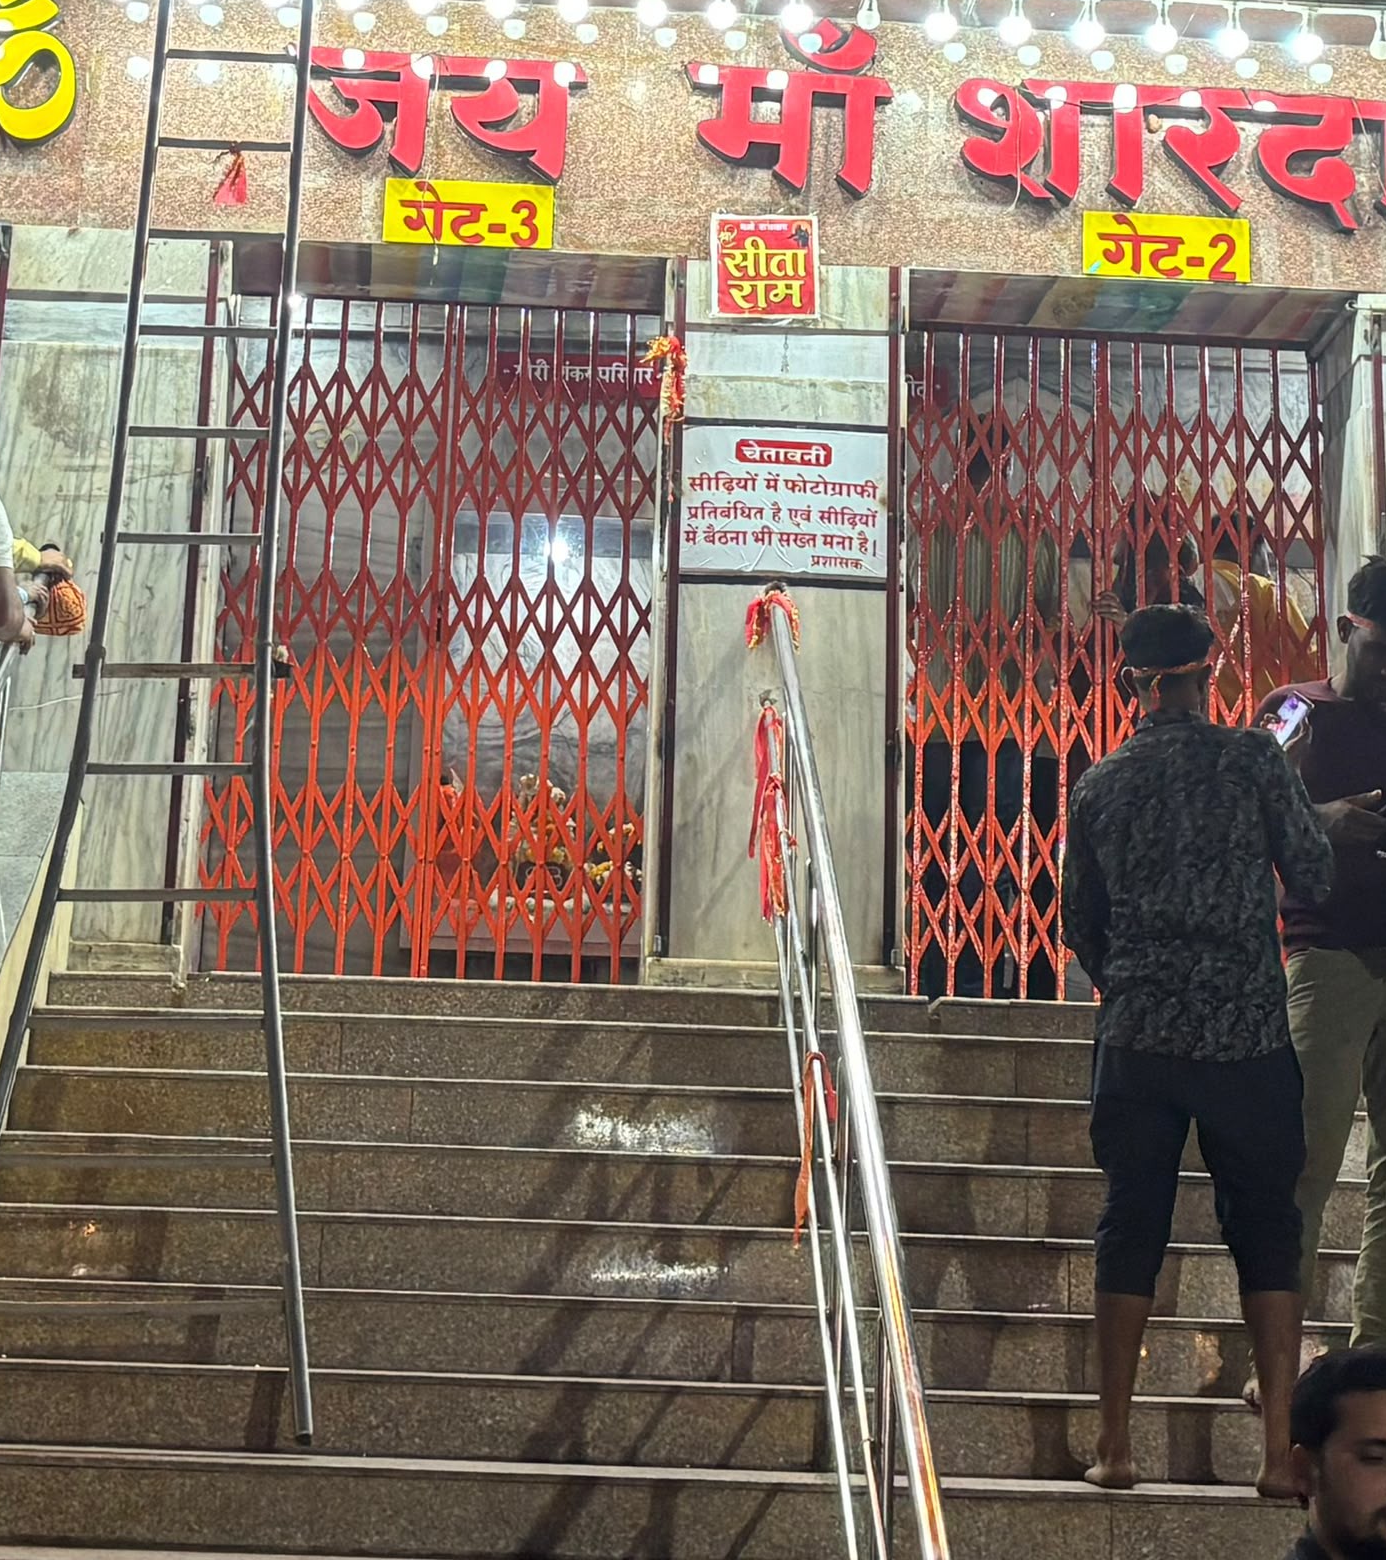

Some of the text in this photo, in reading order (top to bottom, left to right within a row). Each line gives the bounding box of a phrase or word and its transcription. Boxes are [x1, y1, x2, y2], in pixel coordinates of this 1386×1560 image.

[307, 46, 590, 183] जय
[722, 236, 808, 278] सीता
[727, 280, 805, 310] राम
[740, 440, 827, 465] चेतावनी
[688, 471, 879, 500] सीढ़ियों में फोटोग्राफी
[687, 500, 879, 530] प्रतिबंधित है एवं सीढ़ियों
[683, 523, 698, 546] में
[703, 523, 747, 546] बैठना
[751, 525, 773, 547] भी
[777, 530, 817, 549] सख्त
[821, 532, 854, 551] मना
[810, 554, 864, 570] प्रशासक
